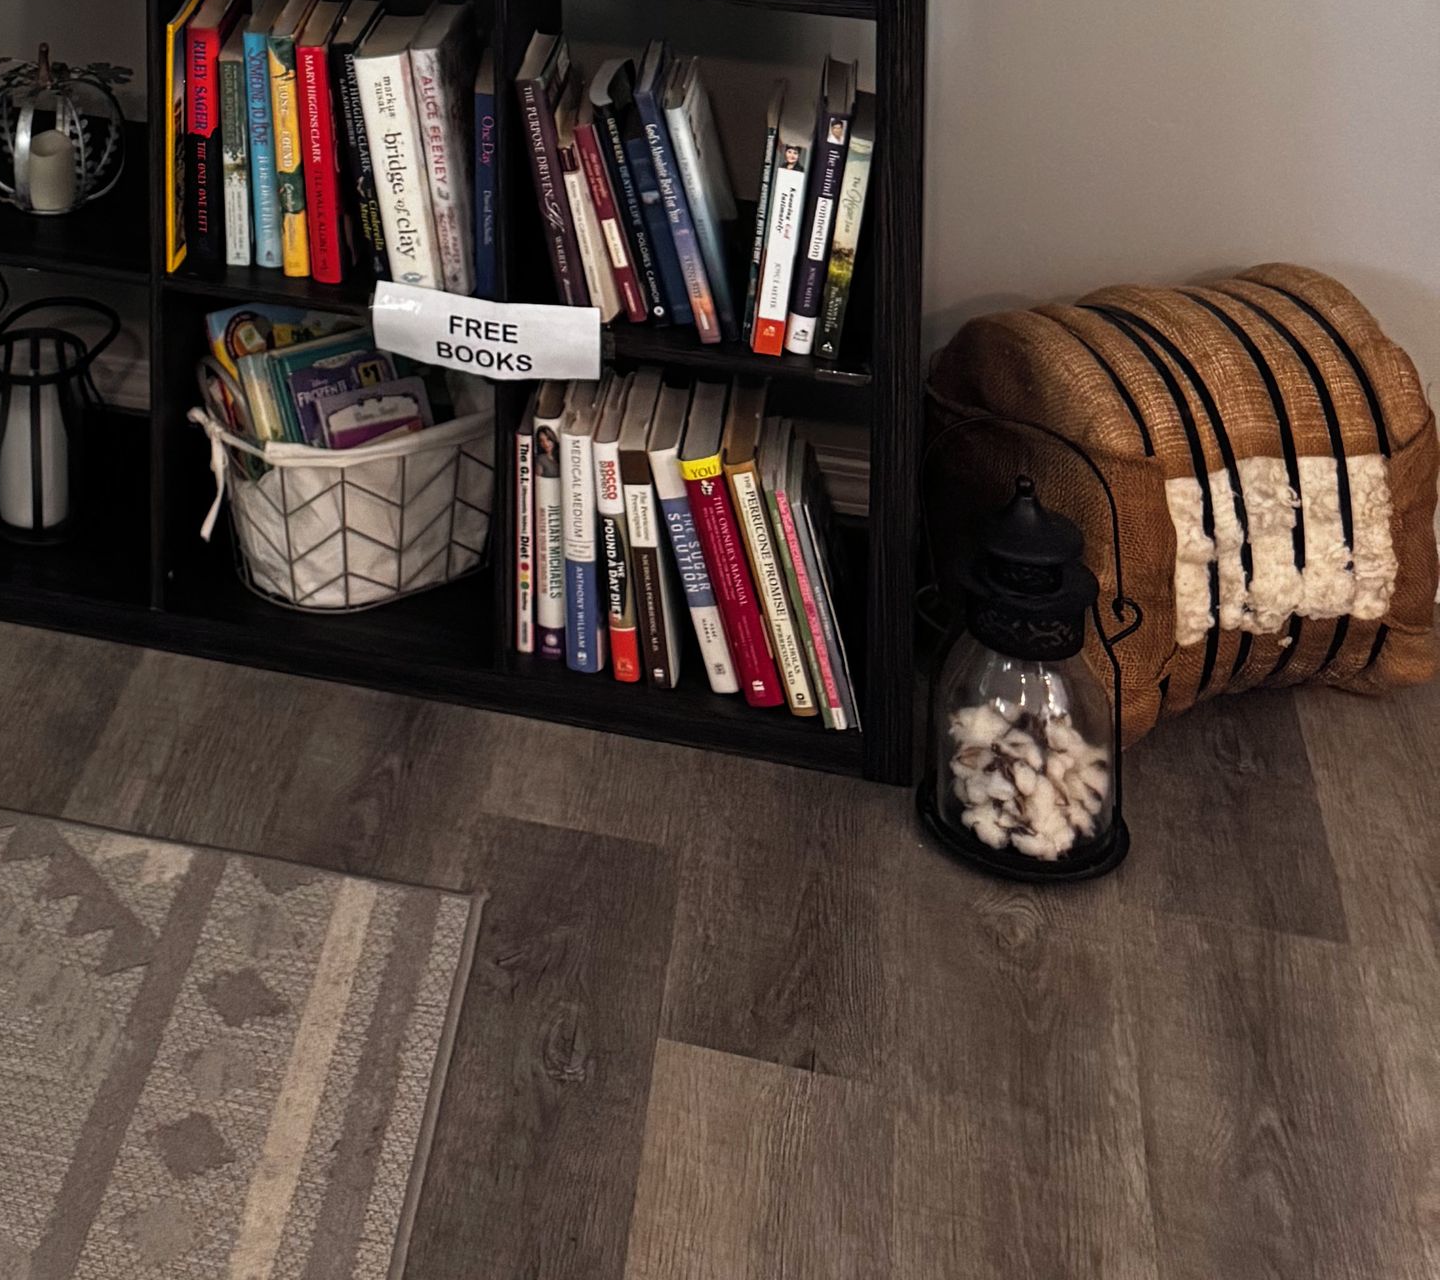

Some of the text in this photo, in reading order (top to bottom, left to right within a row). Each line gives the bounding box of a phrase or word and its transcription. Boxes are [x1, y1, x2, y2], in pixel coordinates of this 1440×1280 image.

[194, 40, 208, 130] RILEY SAGER
[223, 64, 236, 144] NORA ROBERTS
[248, 48, 270, 146] SOMEONE TO LOVE
[304, 54, 322, 163] MARY HIGGINS CLARK
[340, 84, 352, 119] ALAFAIR
[374, 82, 387, 114] zusak
[383, 76, 396, 118] markus
[343, 53, 372, 174] MARY HIGGINS CLARK
[421, 76, 447, 184] ALICE FEENEY
[282, 131, 292, 167] FOUND
[479, 115, 495, 167] One Day
[522, 86, 566, 234] THE PURPOSE DRIVEN Life
[197, 141, 208, 233] THE ONLY ONE LEFT
[606, 117, 625, 164] BETWEEN
[619, 166, 633, 197] DEATH
[628, 205, 642, 225] LIFE
[644, 123, 679, 223] God's Absolute Best For You
[852, 177, 861, 188] The
[384, 132, 418, 261] bridge of clay
[775, 192, 787, 234] Intimately
[785, 187, 796, 221] Knowing
[811, 149, 840, 258] the mind connection
[359, 202, 372, 241] Murder
[367, 199, 384, 251] Cinderella
[553, 236, 568, 273] WARREN
[635, 232, 660, 303] DOLORES CANNON
[449, 315, 518, 344] FREE
[437, 341, 533, 371] BOOKS
[520, 443, 530, 462] The
[520, 466, 530, 484] G.I.
[691, 464, 717, 479] YOU
[570, 439, 582, 538] MEDICAL MEDIUM
[606, 460, 618, 500] ROCCO
[713, 496, 725, 515] THE
[520, 535, 530, 559] Diet
[548, 505, 563, 599] JILLIAN MICHAELS
[667, 513, 700, 593] SOLUTION
[682, 513, 709, 591] THE SUGAR
[718, 517, 736, 561] OWNER'S
[745, 490, 767, 560] PERRICONE
[762, 562, 786, 617] PROMISE
[603, 518, 622, 620] POUND A DAY DIET
[617, 561, 625, 578] THE
[641, 554, 652, 591] NICHOLAS
[729, 563, 748, 607] MANUAL
[575, 566, 585, 648] ANTHONY WILLIAM
[785, 634, 801, 675] NICHOLAS
